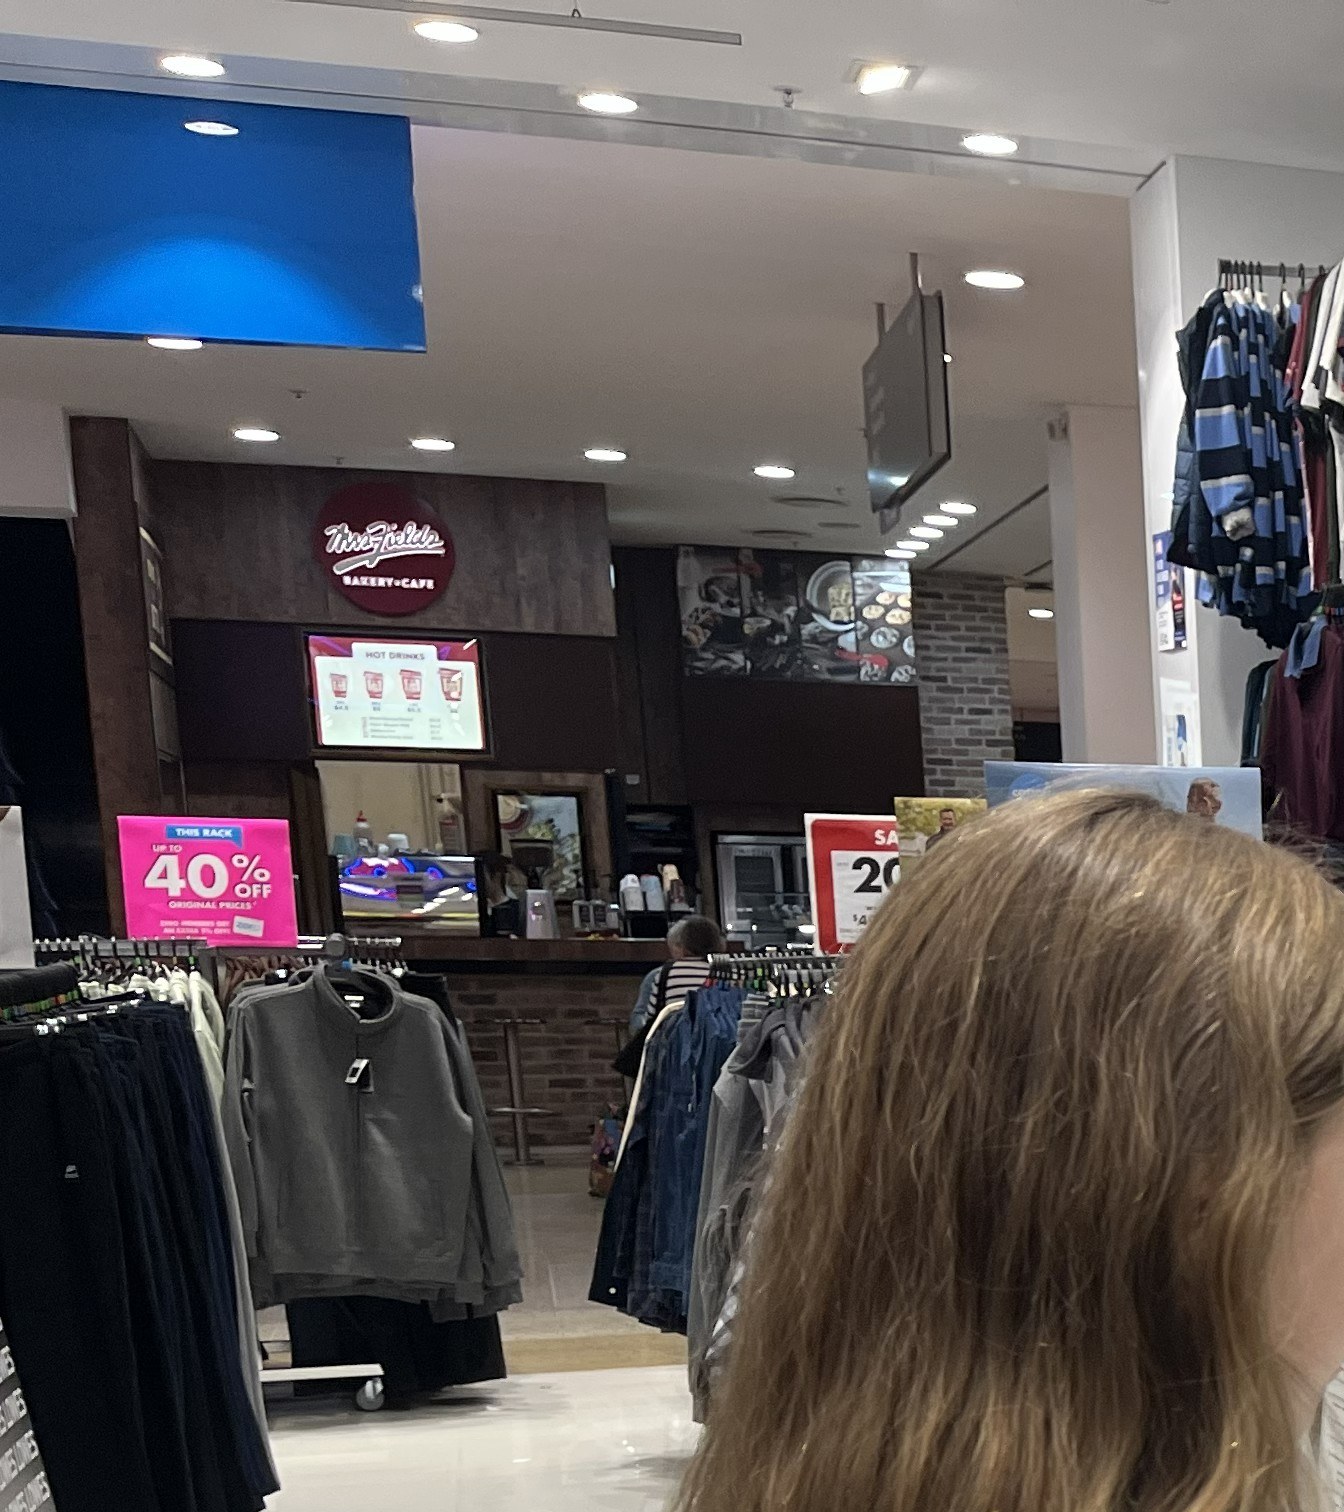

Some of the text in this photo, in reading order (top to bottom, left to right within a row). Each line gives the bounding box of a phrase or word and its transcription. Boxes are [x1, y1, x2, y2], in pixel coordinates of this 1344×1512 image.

[365, 651, 425, 661] HOT DRINKS
[175, 828, 232, 839] THIS RACK
[874, 829, 900, 846] SA
[152, 844, 183, 852] UP TO
[234, 883, 272, 899] OFF
[168, 901, 218, 909] ORIGINAL
